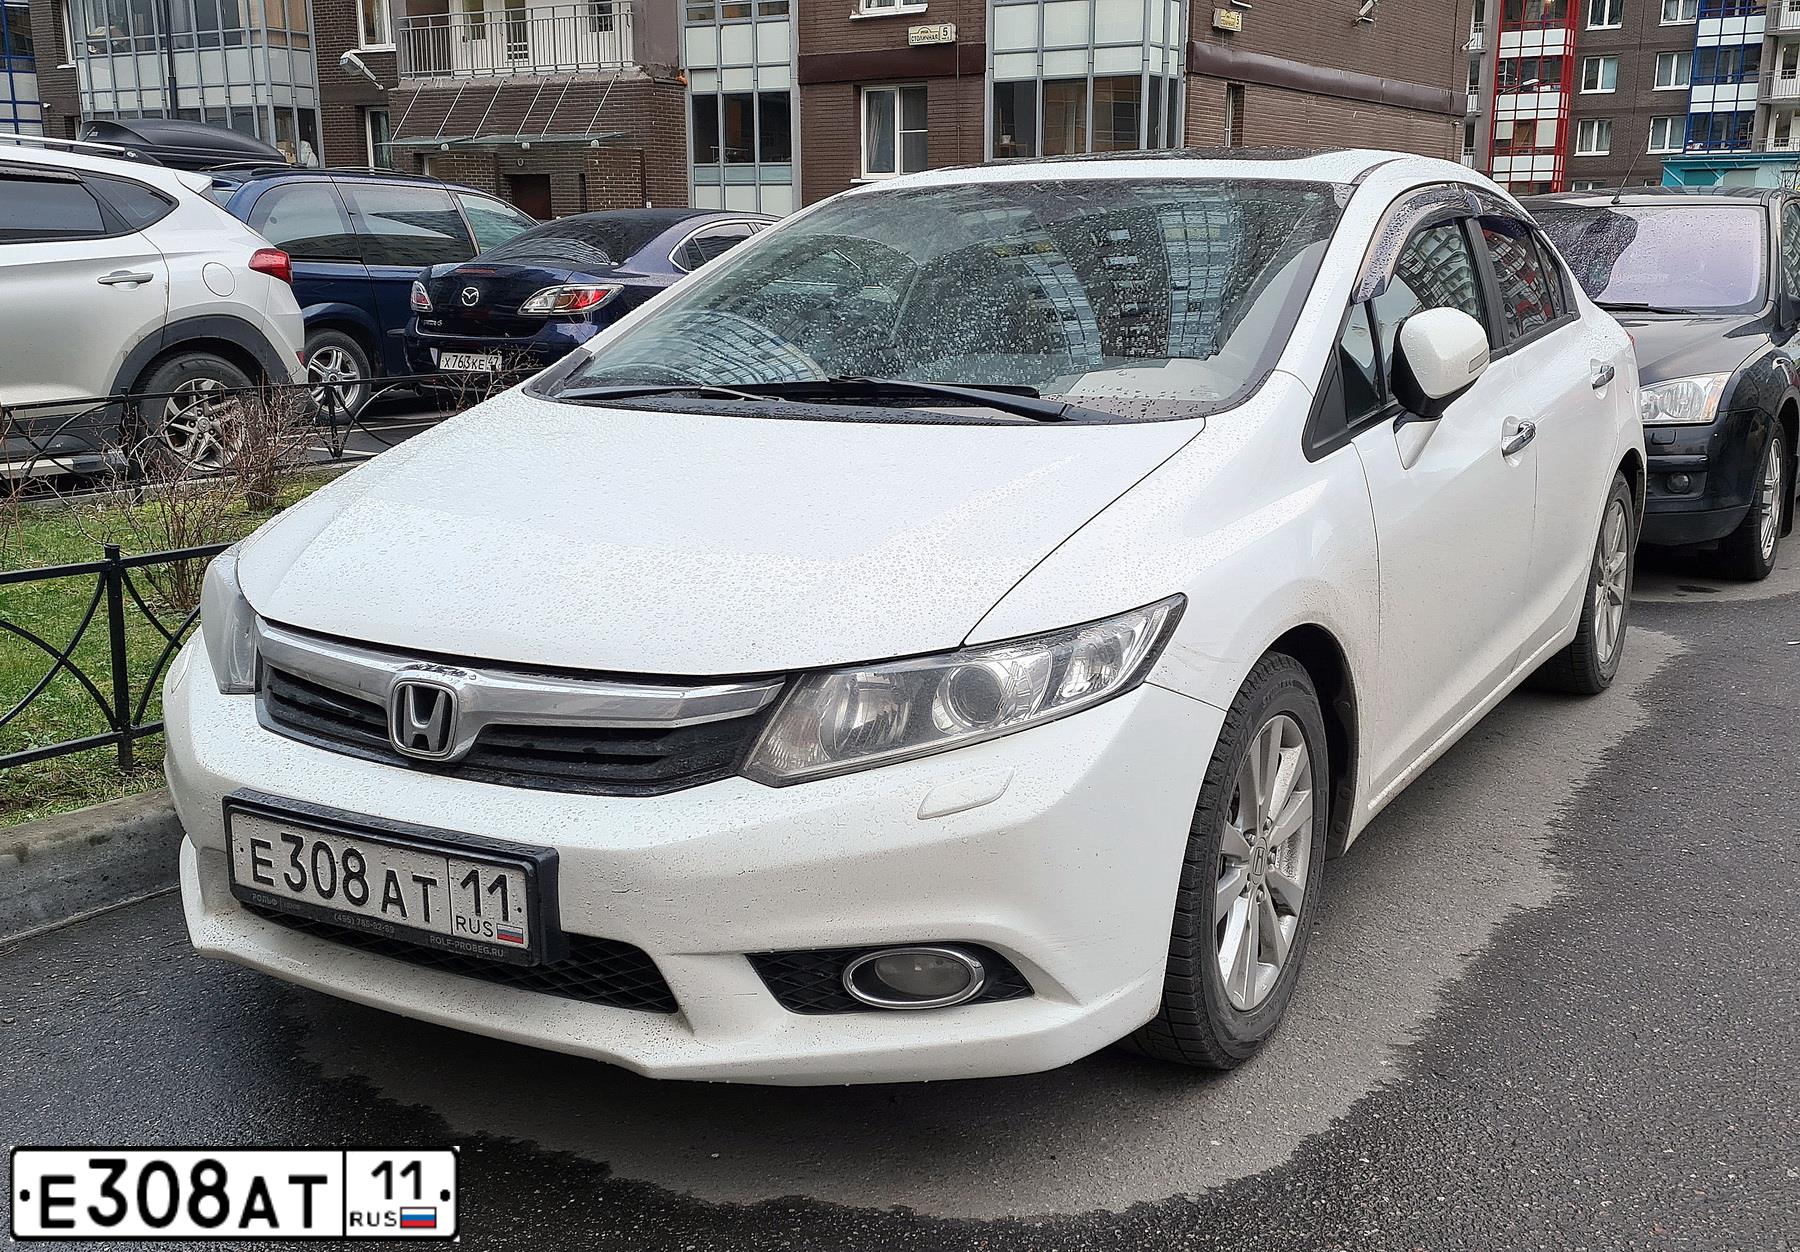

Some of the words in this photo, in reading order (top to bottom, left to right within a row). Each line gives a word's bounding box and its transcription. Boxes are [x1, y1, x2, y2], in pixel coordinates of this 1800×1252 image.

[942, 26, 949, 37] 5
[250, 832, 438, 923] Е308АТ
[460, 869, 510, 922] 11
[455, 914, 494, 938] RUS
[430, 935, 504, 958] ROLF-PROBEG.RU
